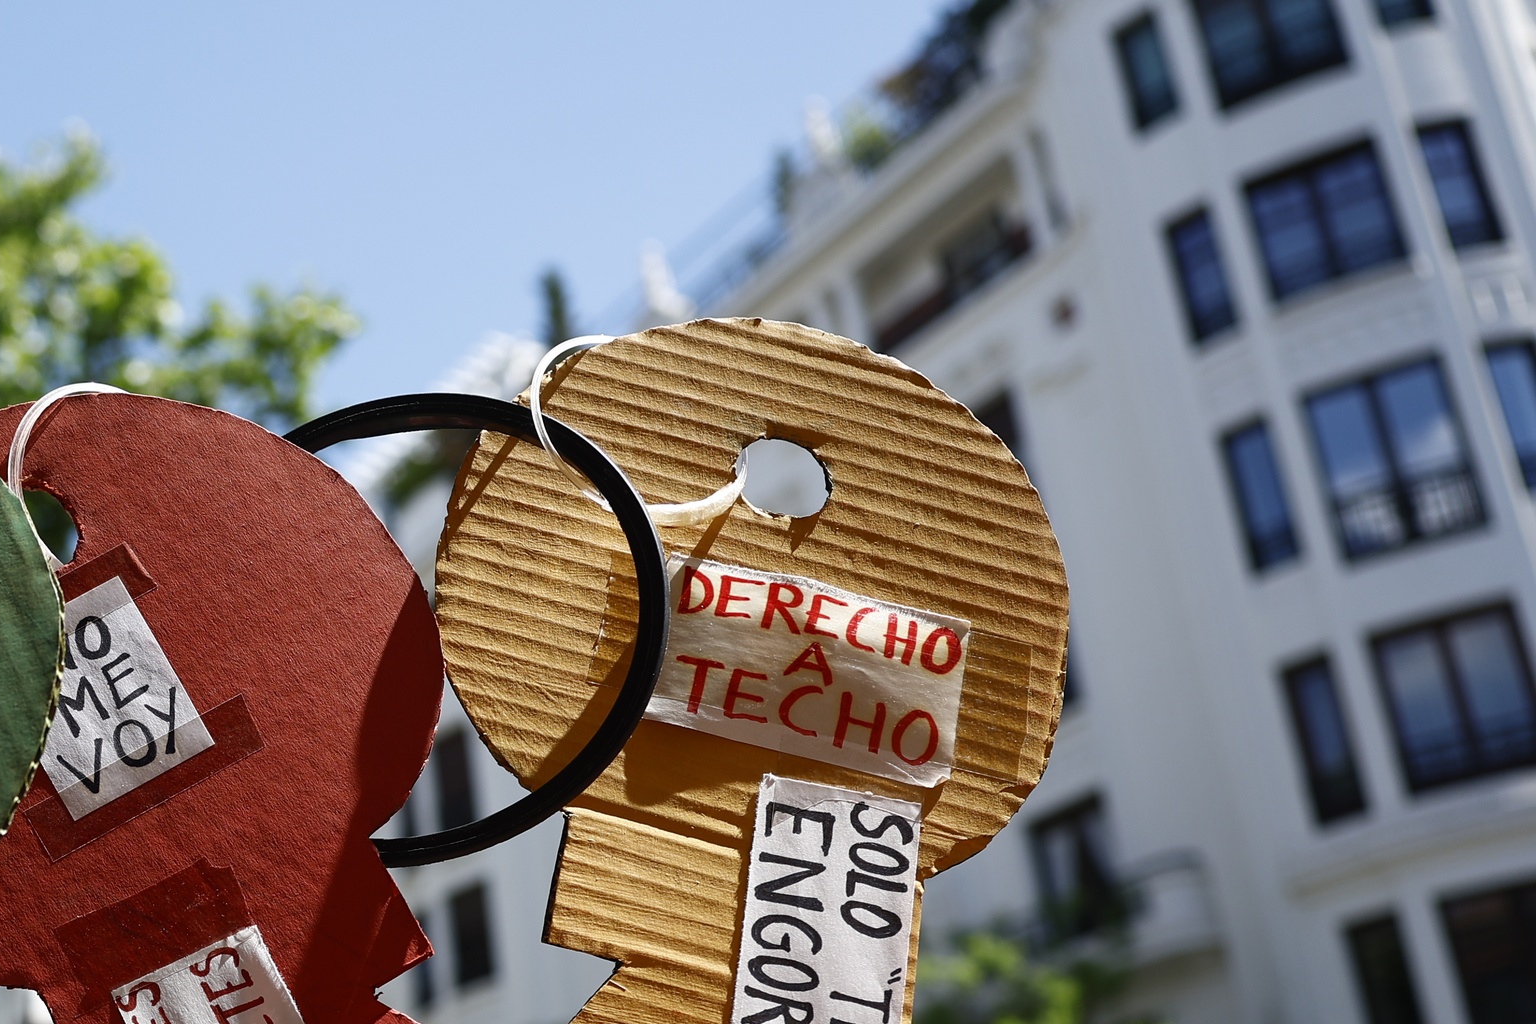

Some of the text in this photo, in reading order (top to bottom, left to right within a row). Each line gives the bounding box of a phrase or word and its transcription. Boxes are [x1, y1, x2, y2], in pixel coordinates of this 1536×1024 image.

[64, 615, 112, 670] O
[677, 565, 962, 675] DERECHO
[783, 641, 833, 687] A
[56, 686, 176, 794] VOY
[59, 652, 150, 738] ME
[676, 655, 939, 766] TECHO
[839, 801, 915, 939] SOLO
